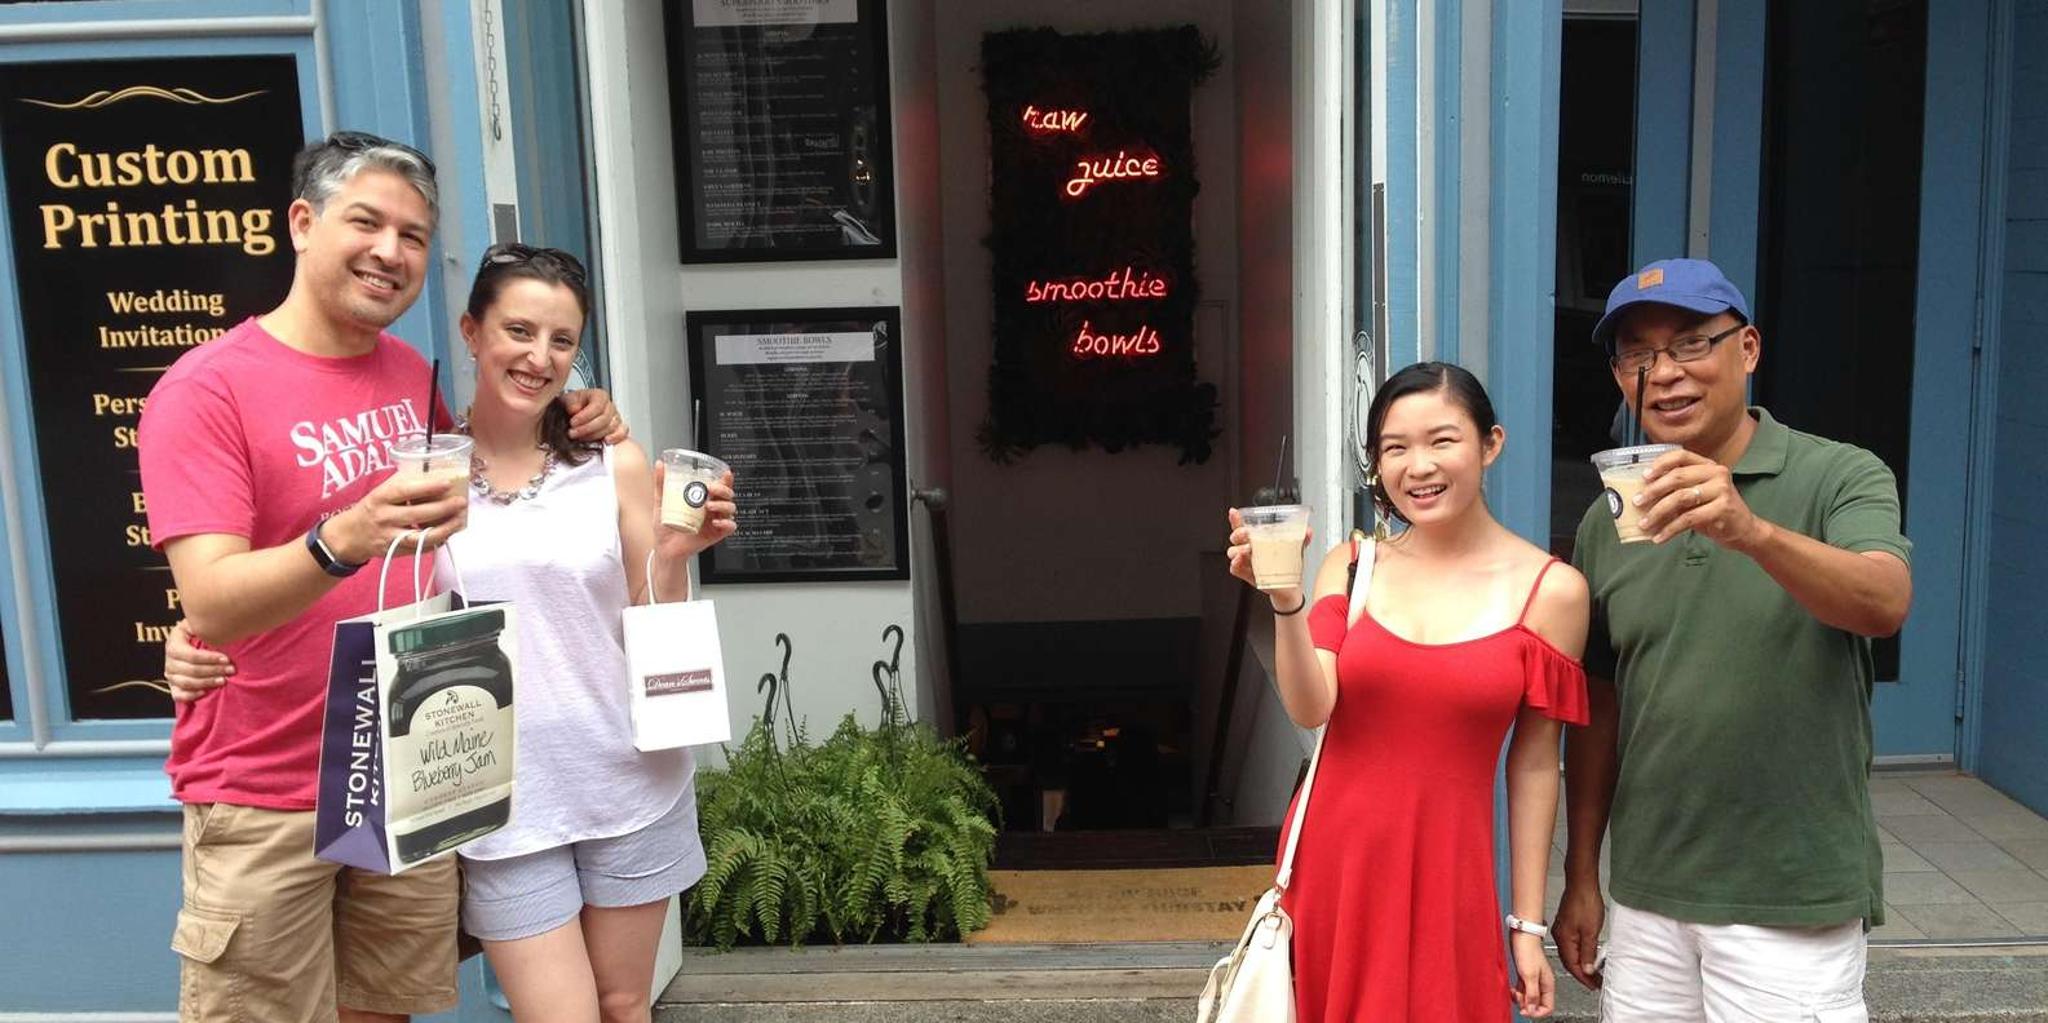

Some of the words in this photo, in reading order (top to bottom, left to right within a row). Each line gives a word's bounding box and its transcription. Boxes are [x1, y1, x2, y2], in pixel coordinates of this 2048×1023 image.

[1023, 105, 1088, 131] raw
[45, 142, 256, 188] Custom
[1067, 150, 1160, 196] juice
[40, 199, 275, 256] Printing
[1027, 267, 1167, 302] smoothie
[106, 289, 226, 317] Wedding
[1073, 320, 1160, 354] bowls
[290, 398, 427, 467] SAMUEL
[425, 700, 482, 720] STONEWALL
[434, 711, 475, 727] KITCHEN
[420, 739, 452, 765] Wild
[453, 727, 494, 755] Maine
[464, 750, 496, 774] Jam
